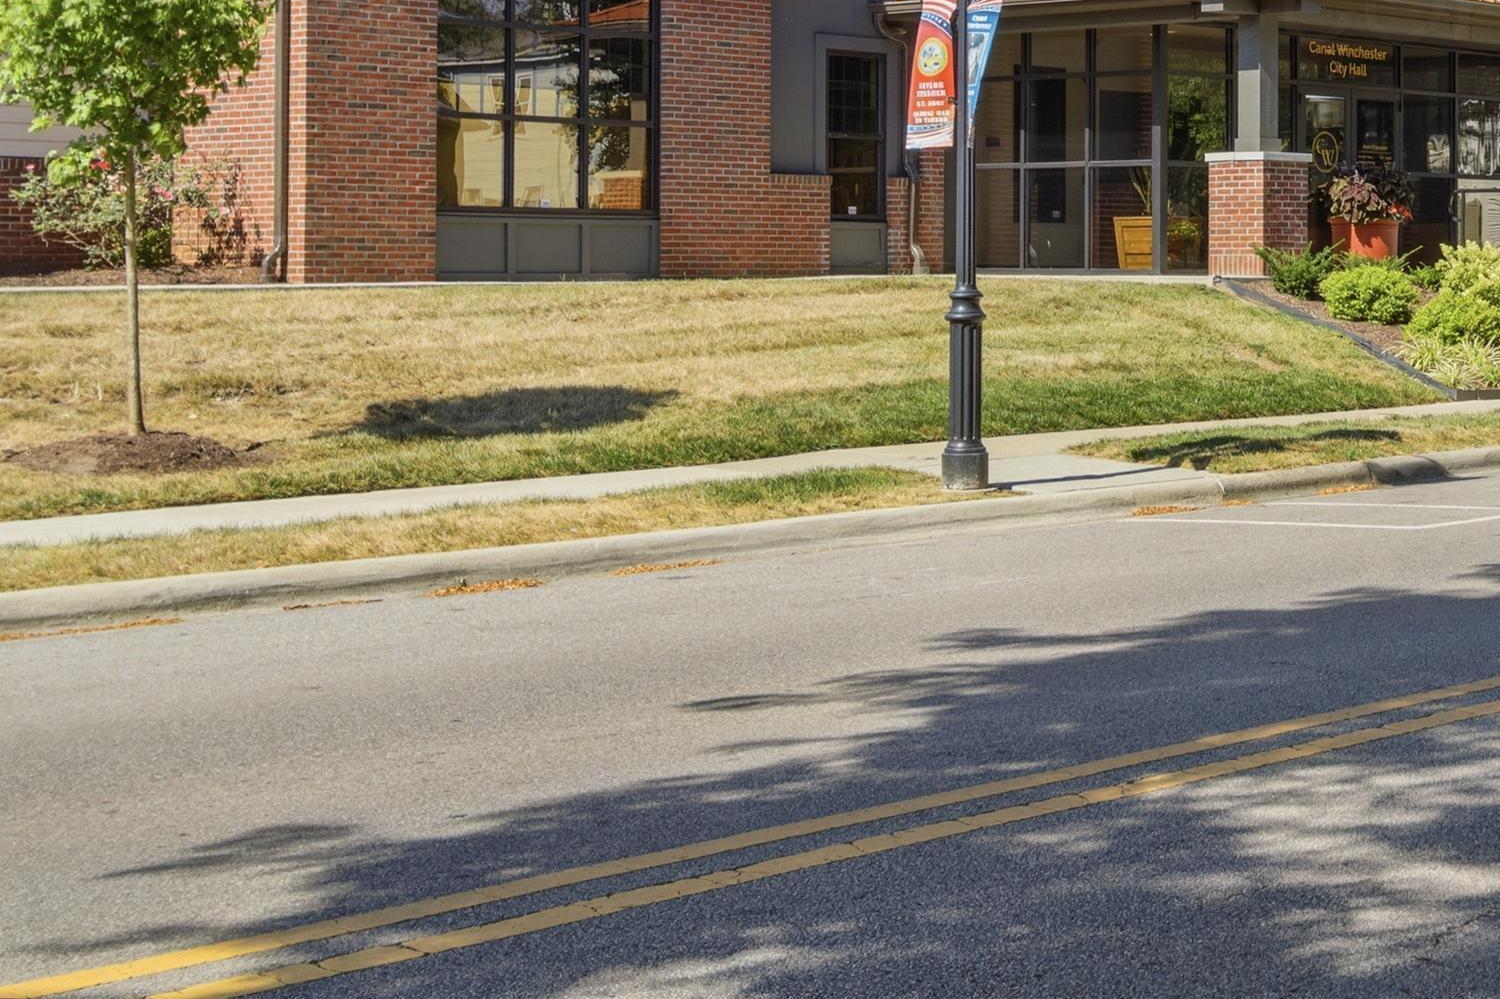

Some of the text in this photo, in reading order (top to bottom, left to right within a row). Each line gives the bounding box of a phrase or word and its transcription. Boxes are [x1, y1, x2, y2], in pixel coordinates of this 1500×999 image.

[1309, 41, 1387, 60] Canal Winchester
[1329, 60, 1367, 78] City Hall
